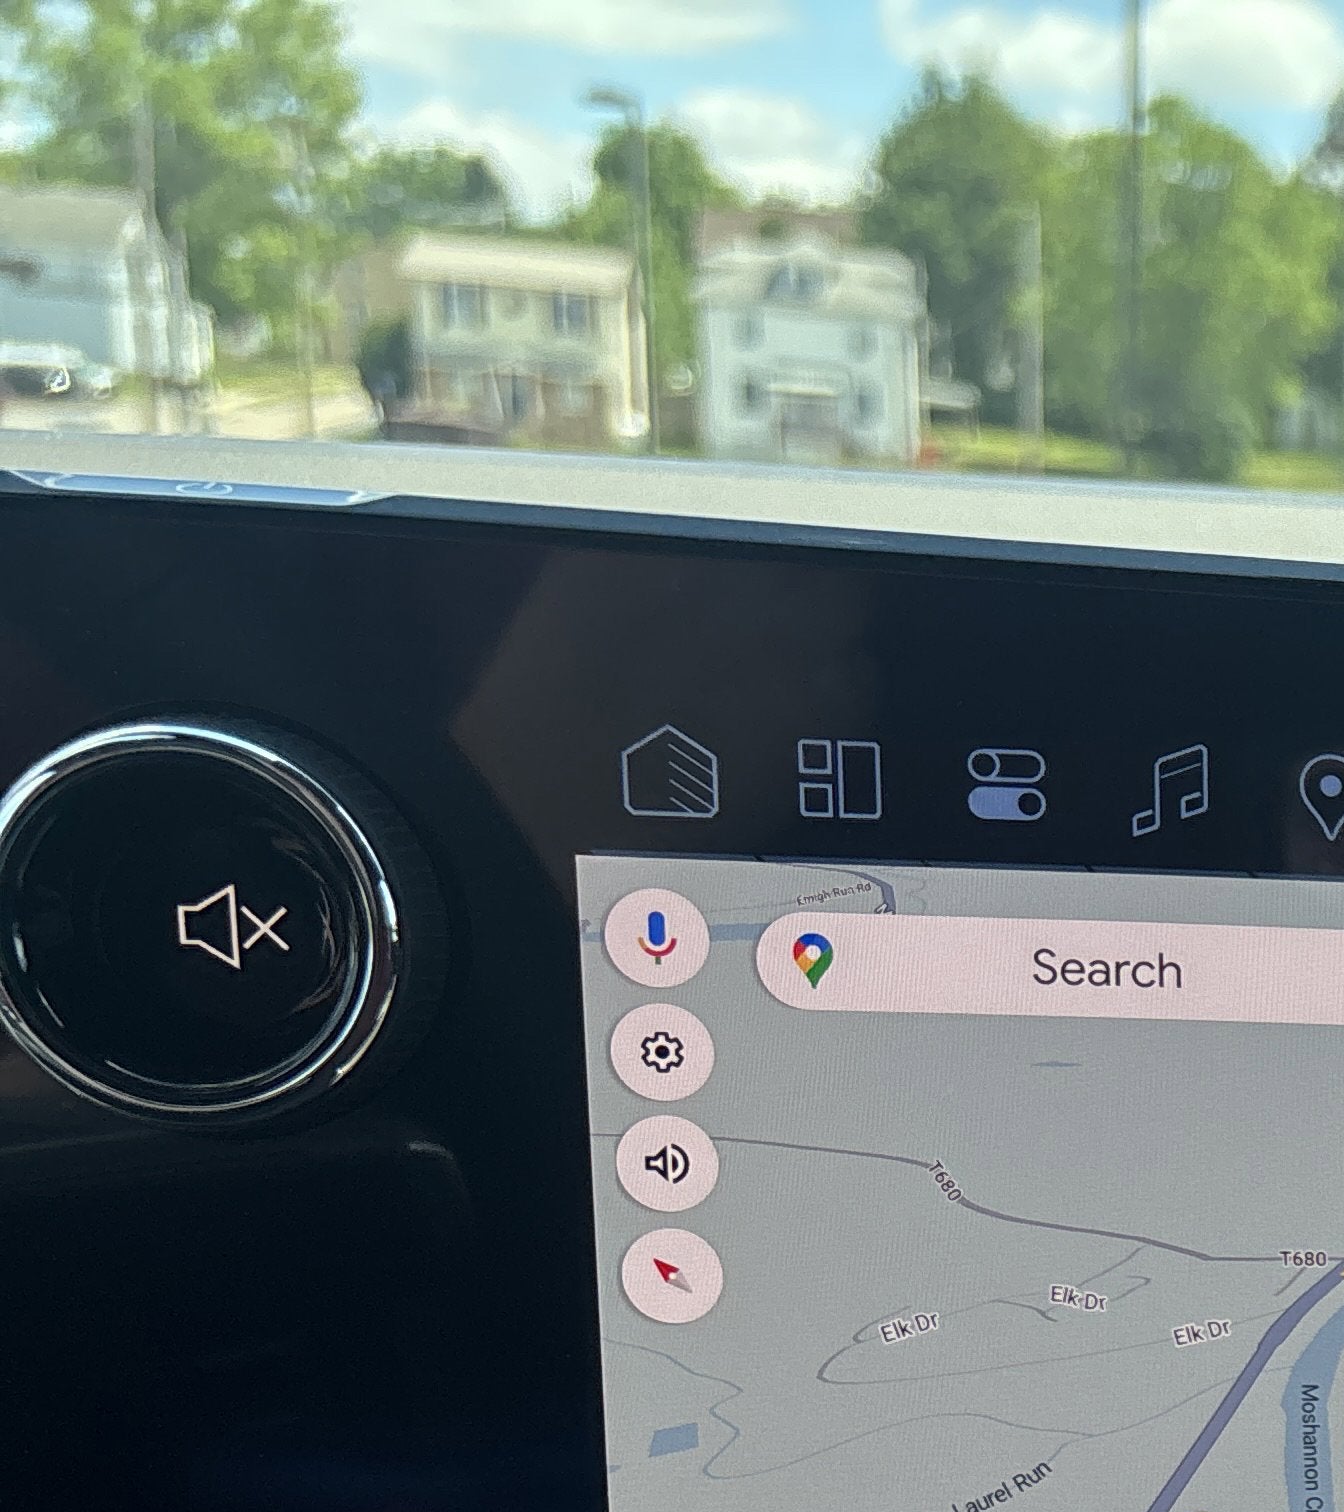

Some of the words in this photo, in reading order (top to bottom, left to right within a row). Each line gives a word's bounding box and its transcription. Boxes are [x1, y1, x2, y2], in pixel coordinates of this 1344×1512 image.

[832, 885, 853, 897] Run
[1033, 948, 1182, 988] Search
[929, 1160, 962, 1203] T680
[1280, 1252, 1327, 1266] T680
[1050, 1286, 1078, 1303] Elk
[1082, 1293, 1107, 1311] Dr
[881, 1321, 912, 1344] Elk
[916, 1313, 939, 1333] Dr
[1173, 1327, 1204, 1347] Elk
[1208, 1320, 1231, 1338] Dr
[1301, 1384, 1324, 1493] Moshannon
[1013, 1462, 1053, 1491] Run
